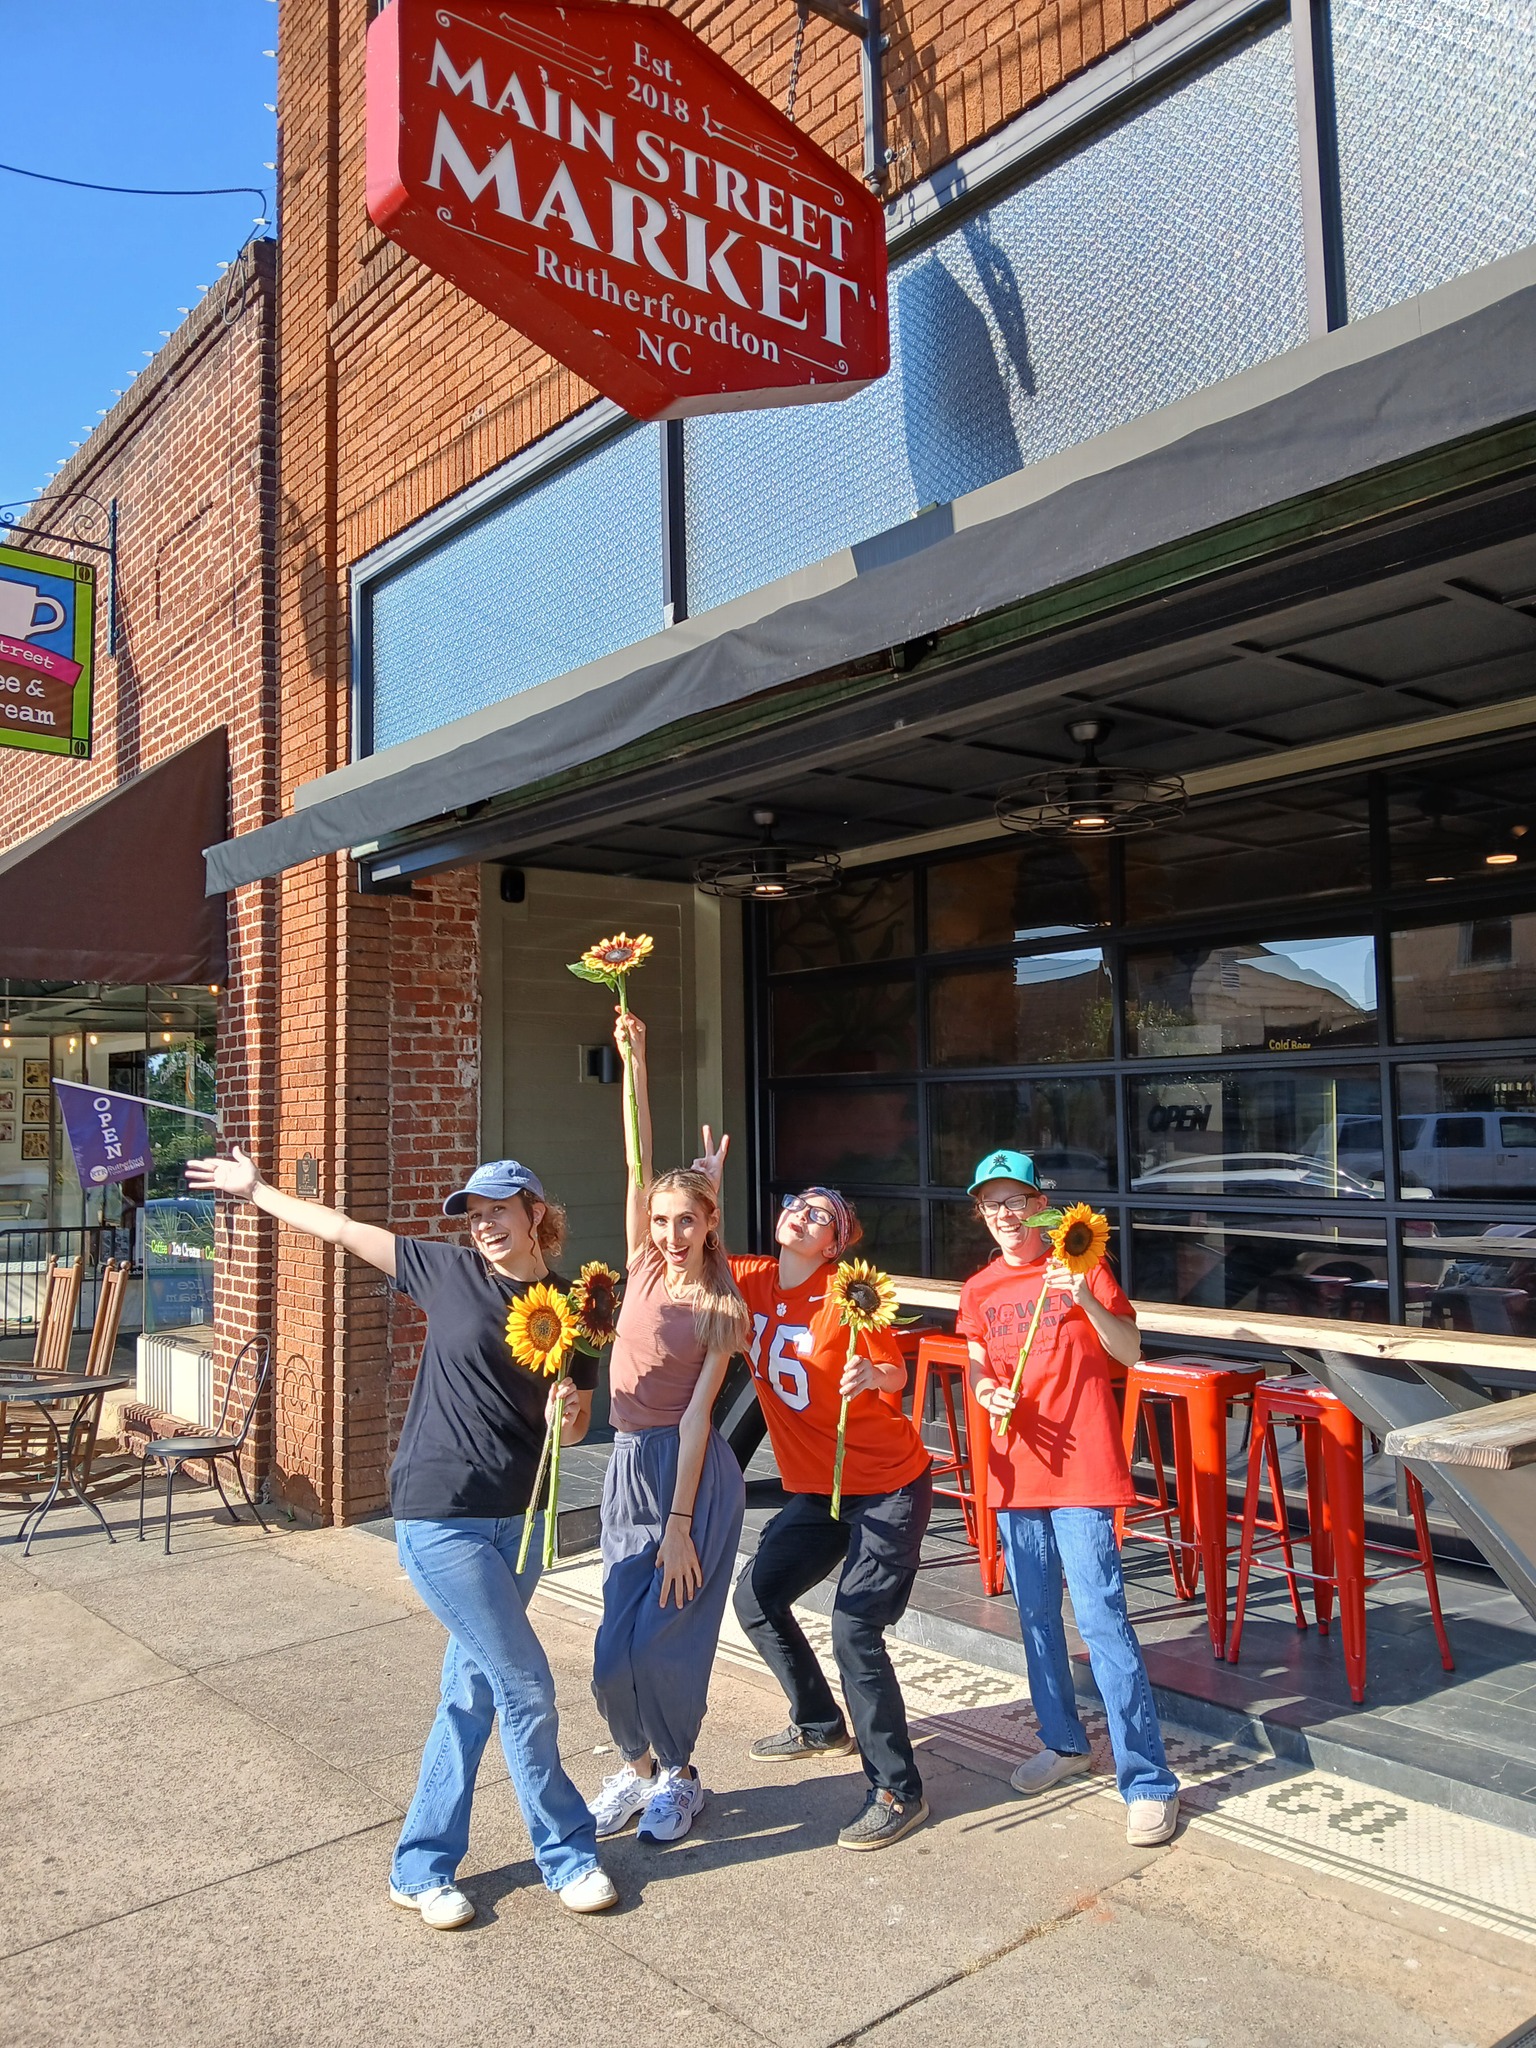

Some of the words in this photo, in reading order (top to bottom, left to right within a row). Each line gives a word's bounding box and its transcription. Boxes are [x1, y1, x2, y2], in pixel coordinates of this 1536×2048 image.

[632, 41, 683, 87] Est.
[626, 76, 690, 125] 2018
[426, 37, 617, 164] MAIN
[634, 130, 854, 263] STREET
[421, 109, 860, 349] MARKET
[534, 244, 781, 364] Rutherfordton
[636, 327, 693, 376] NC
[0, 640, 55, 669] treet
[26, 679, 46, 698] &
[1268, 1039, 1289, 1051] Cold
[92, 1097, 123, 1161] OPEN
[1146, 1104, 1212, 1133] OPEN
[151, 1239, 168, 1255] Coffee
[171, 1241, 181, 1256] Ice
[182, 1242, 201, 1259] Cream
